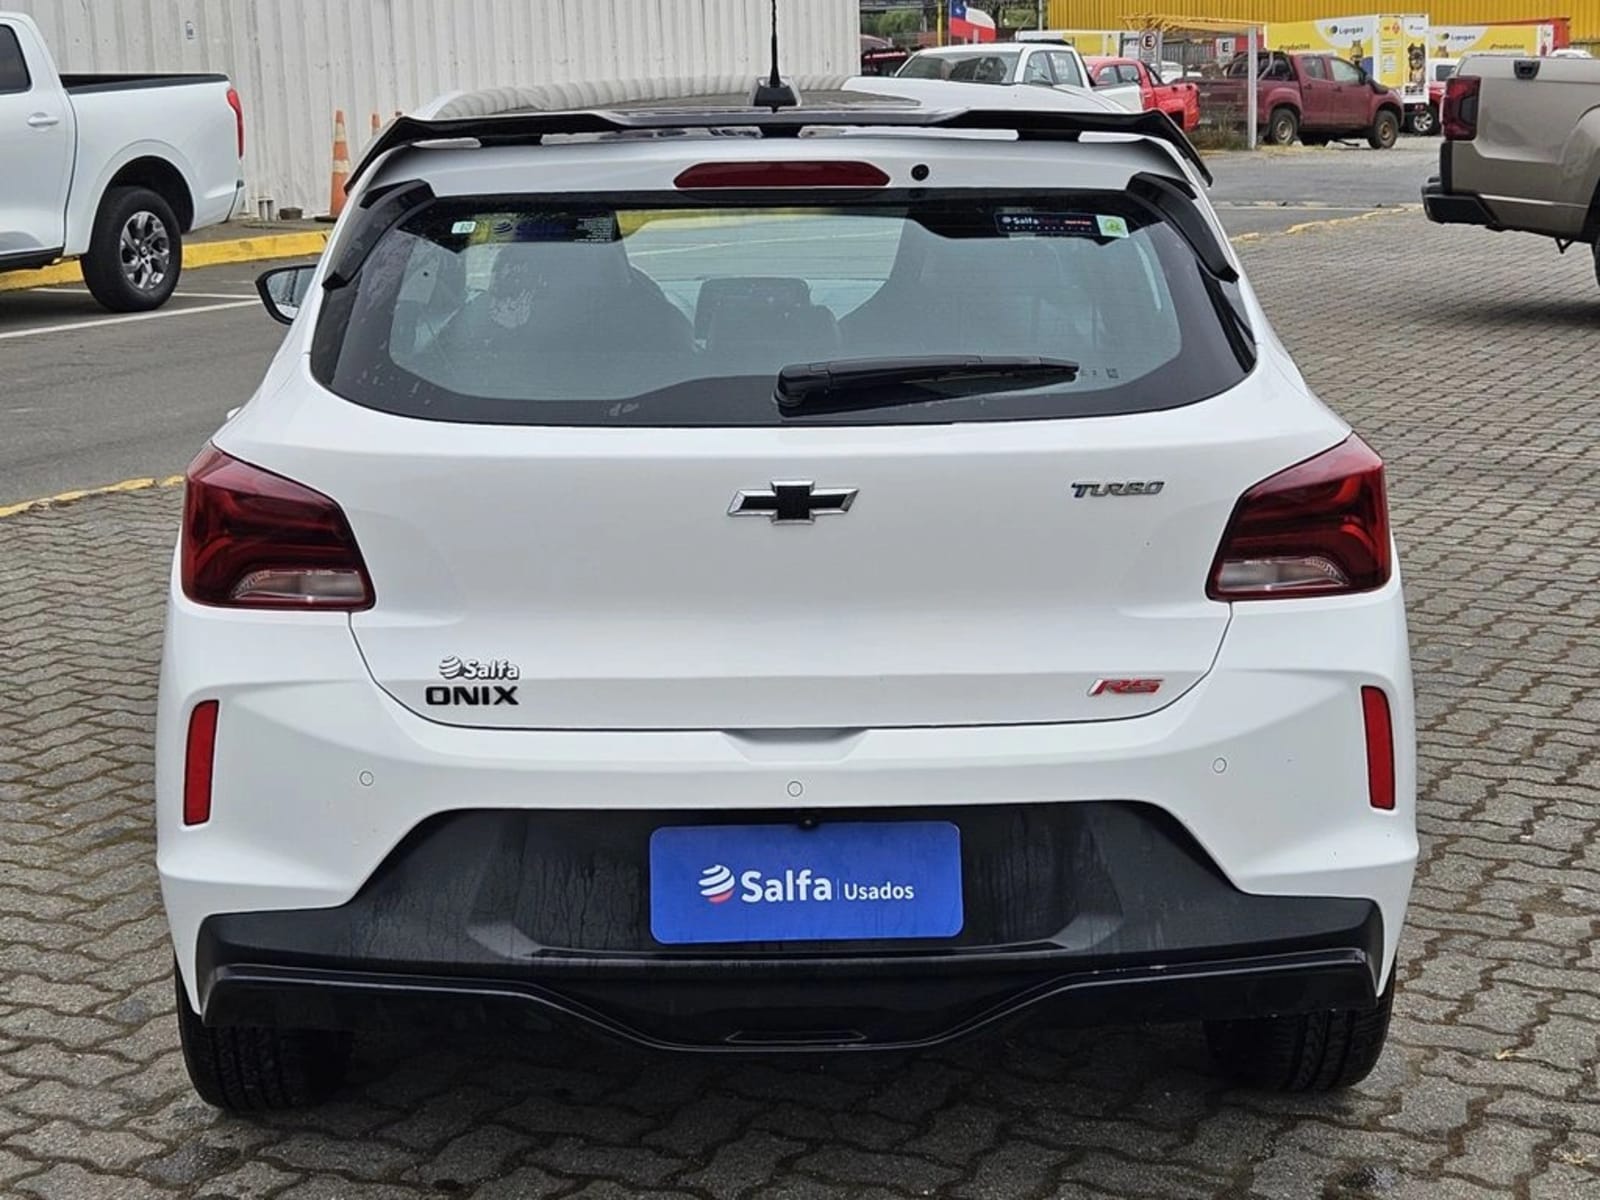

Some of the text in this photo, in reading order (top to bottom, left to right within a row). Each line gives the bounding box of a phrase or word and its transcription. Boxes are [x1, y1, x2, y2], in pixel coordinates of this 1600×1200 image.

[1145, 36, 1153, 47] E
[1222, 42, 1229, 52] E
[1071, 481, 1165, 498] TURBO
[463, 659, 519, 680] Salfa
[425, 686, 519, 705] ONIX
[1087, 679, 1163, 697] RS
[741, 869, 915, 903] Salfa Usados
